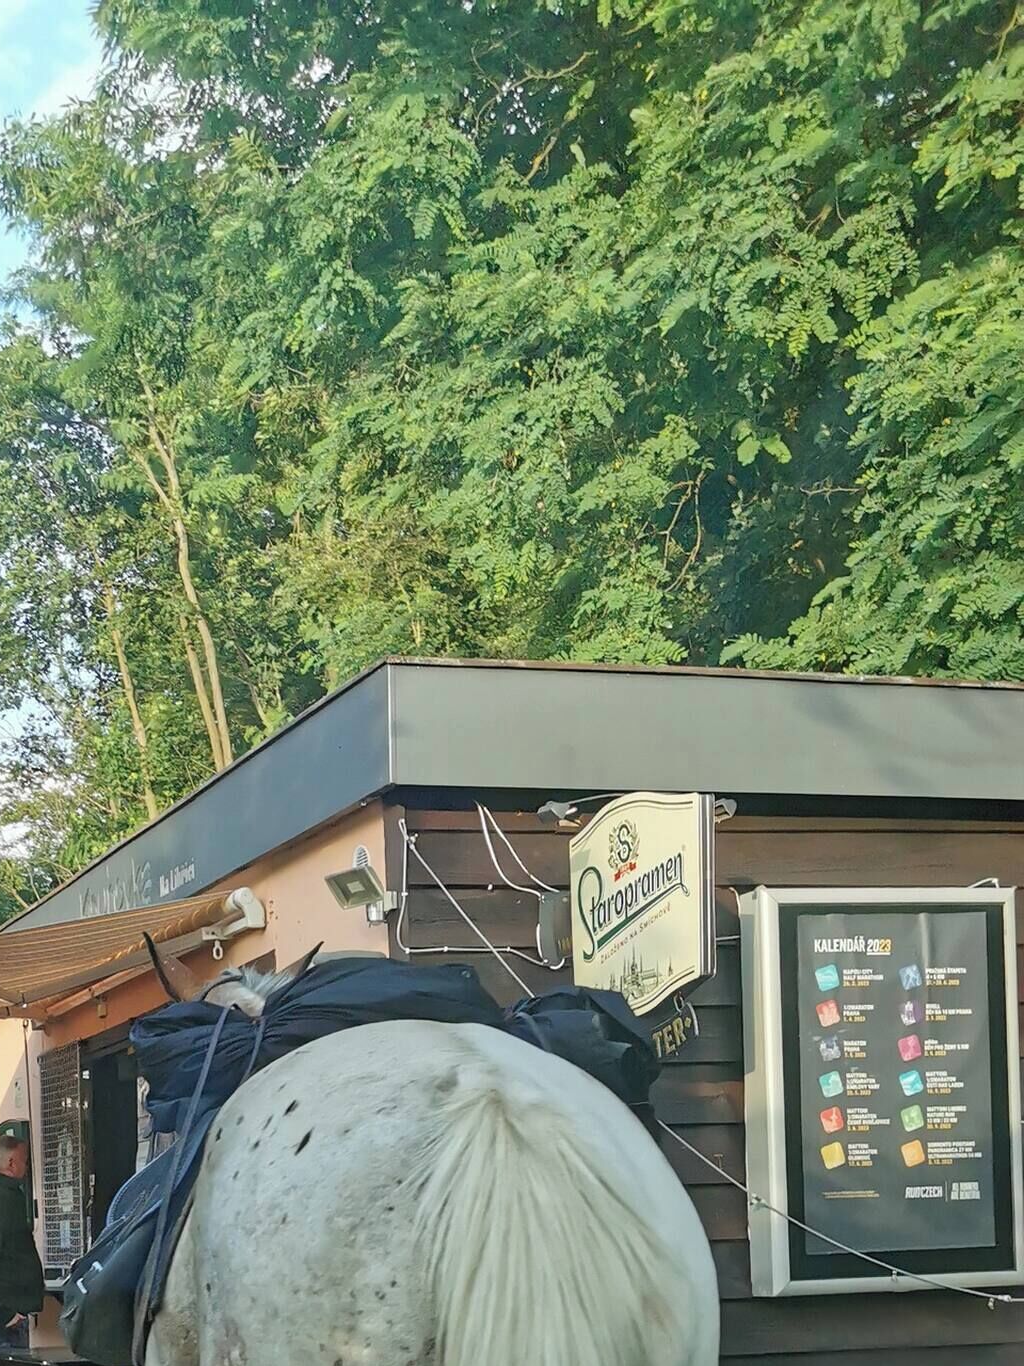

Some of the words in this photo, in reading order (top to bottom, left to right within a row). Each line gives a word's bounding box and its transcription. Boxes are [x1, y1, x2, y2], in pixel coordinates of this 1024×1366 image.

[578, 851, 690, 962] Staropramen
[814, 935, 866, 953] KALENDÁŘ
[866, 938, 892, 953] 2023
